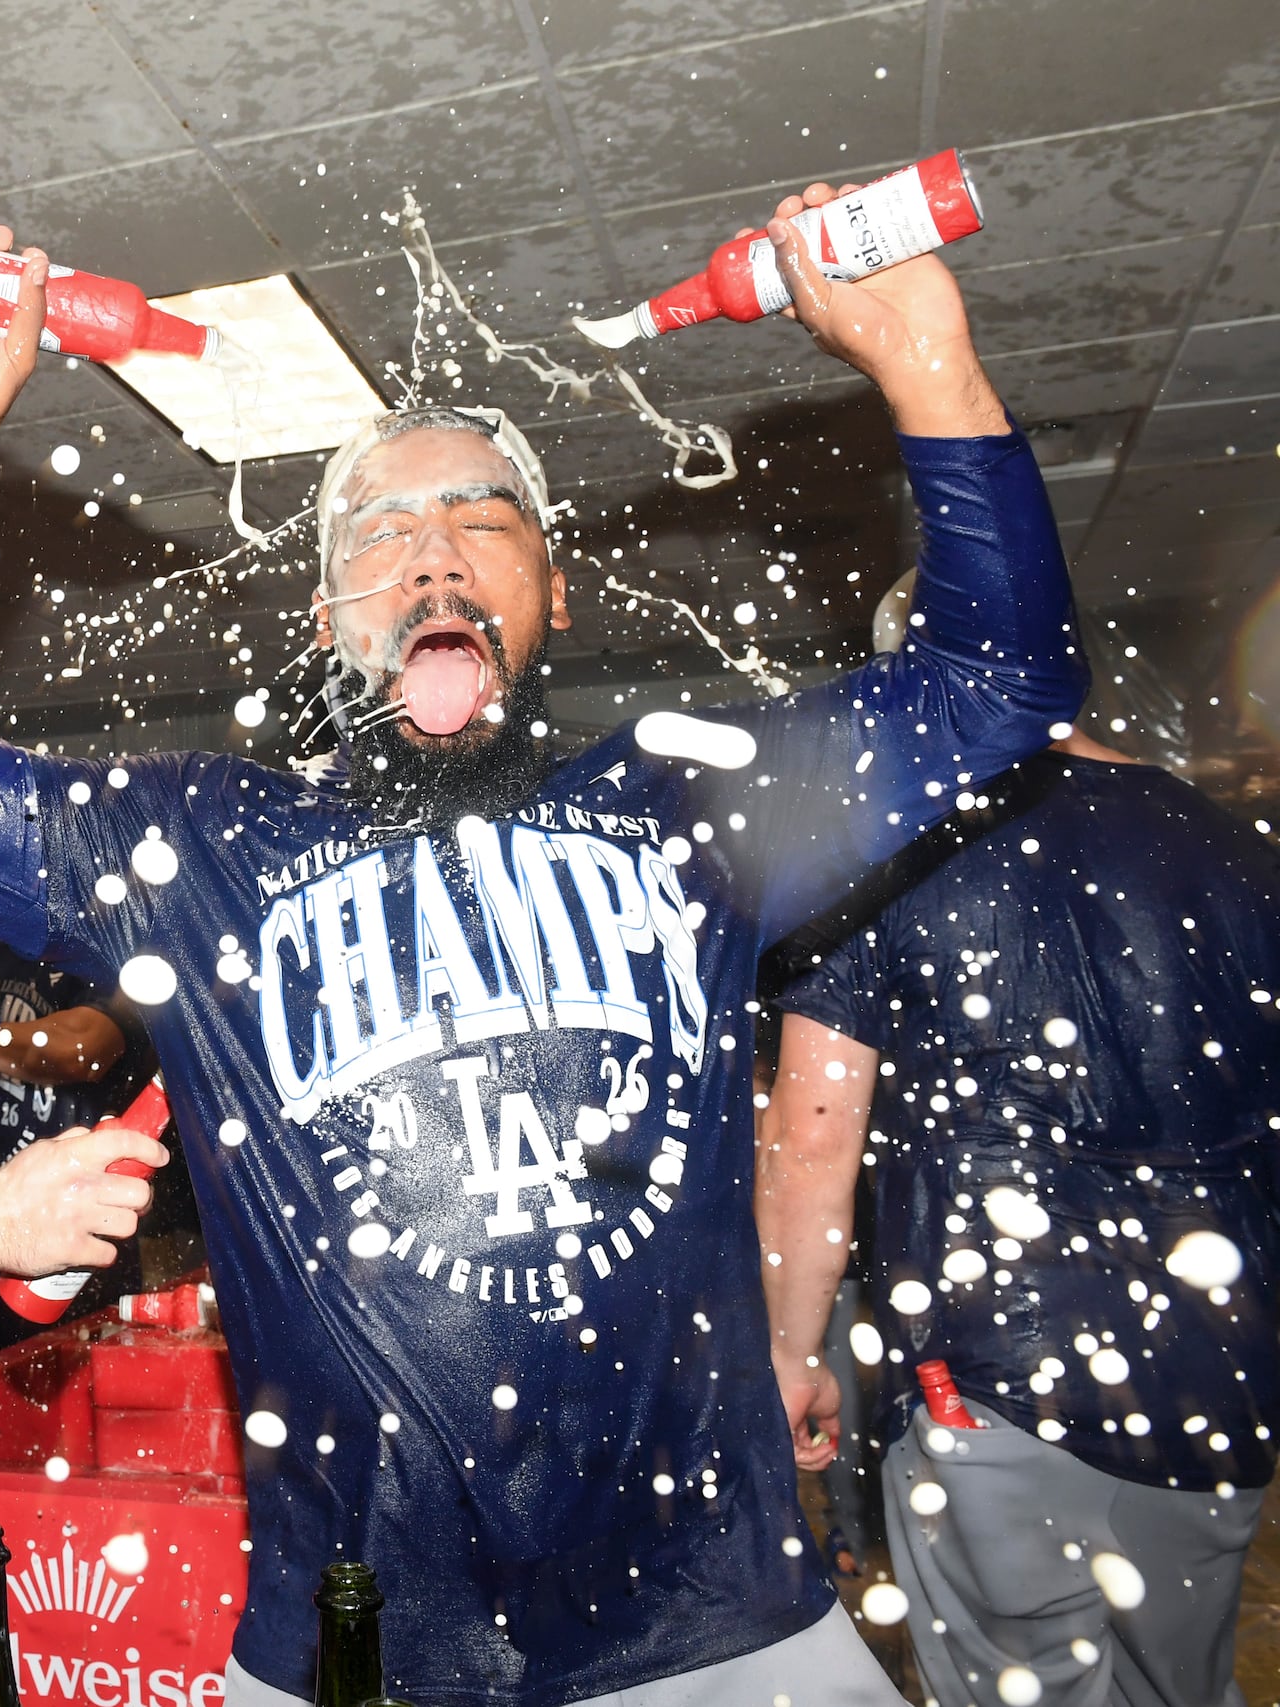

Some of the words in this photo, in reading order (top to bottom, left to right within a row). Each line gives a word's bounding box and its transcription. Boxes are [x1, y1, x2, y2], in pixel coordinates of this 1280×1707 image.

[564, 803, 662, 846] WEST
[259, 823, 708, 1124] CHAMPS
[1, 1102, 19, 1127] 26
[361, 1091, 418, 1151] 20
[599, 1055, 650, 1116] 26
[441, 1055, 593, 1238] LA
[320, 1145, 380, 1218] LOS
[389, 1226, 570, 1304] ANGELES
[587, 1108, 692, 1280] DODGRS
